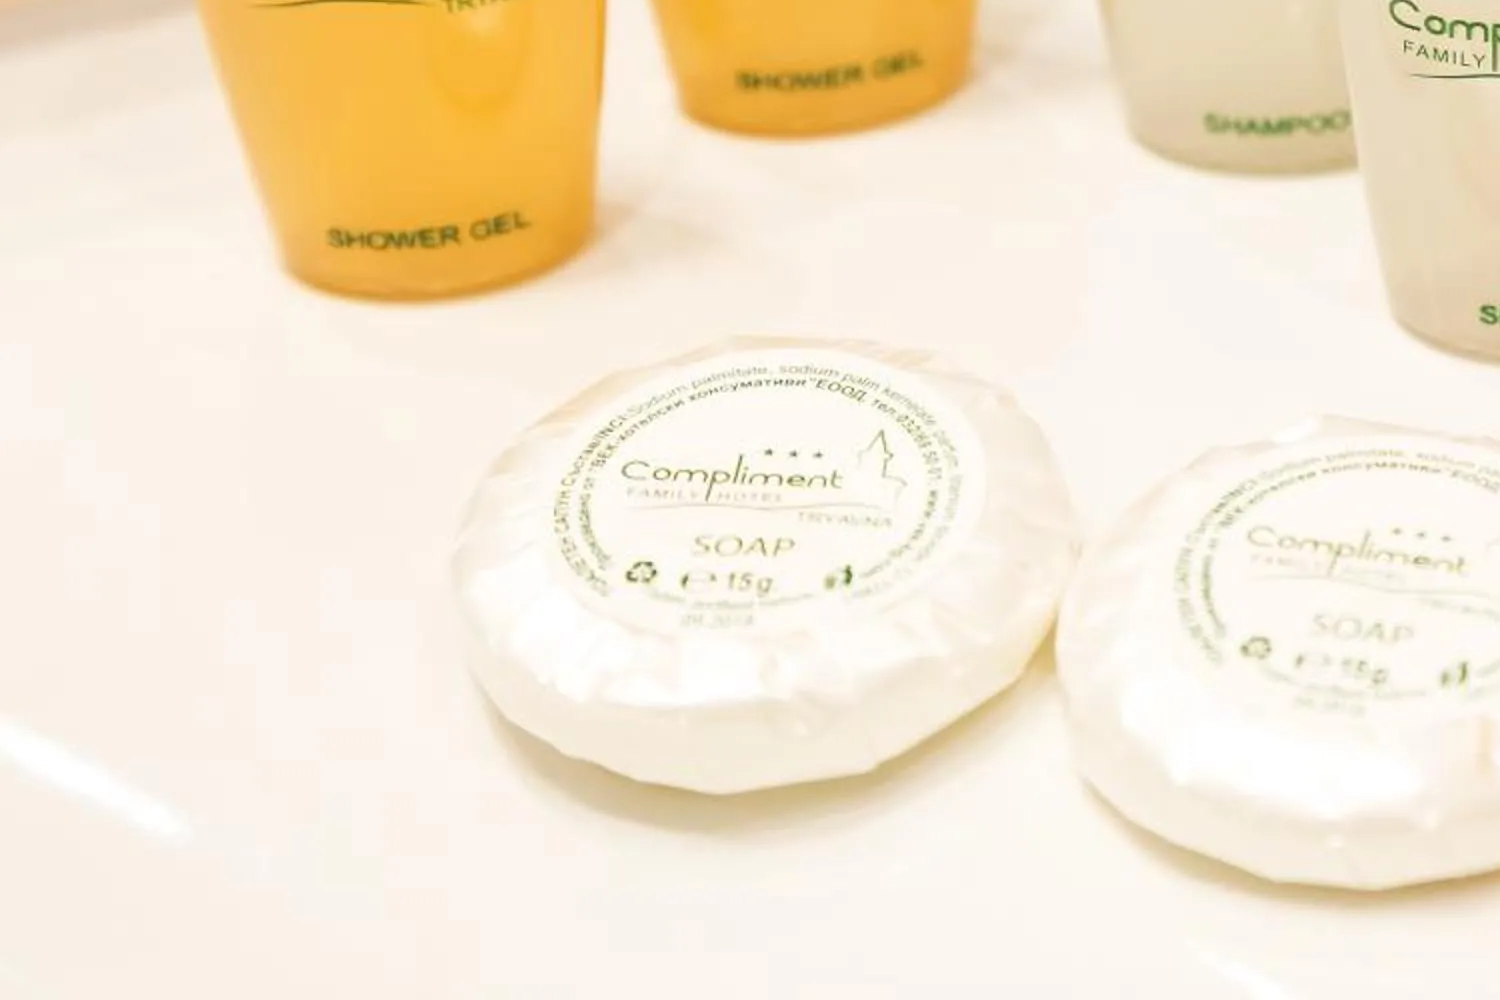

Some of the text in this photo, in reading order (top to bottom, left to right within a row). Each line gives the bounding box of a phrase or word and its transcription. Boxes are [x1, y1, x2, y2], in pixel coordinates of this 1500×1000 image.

[734, 48, 925, 92] SHOWER GEL
[1402, 39, 1487, 70] FAMILY
[1203, 108, 1352, 136] SHAMPOO
[326, 210, 532, 252] SHOWER GEL
[620, 453, 845, 502] Compliment
[692, 534, 796, 558] SOAP
[1247, 525, 1470, 577] Compliment
[1311, 612, 1415, 646] SOAP
